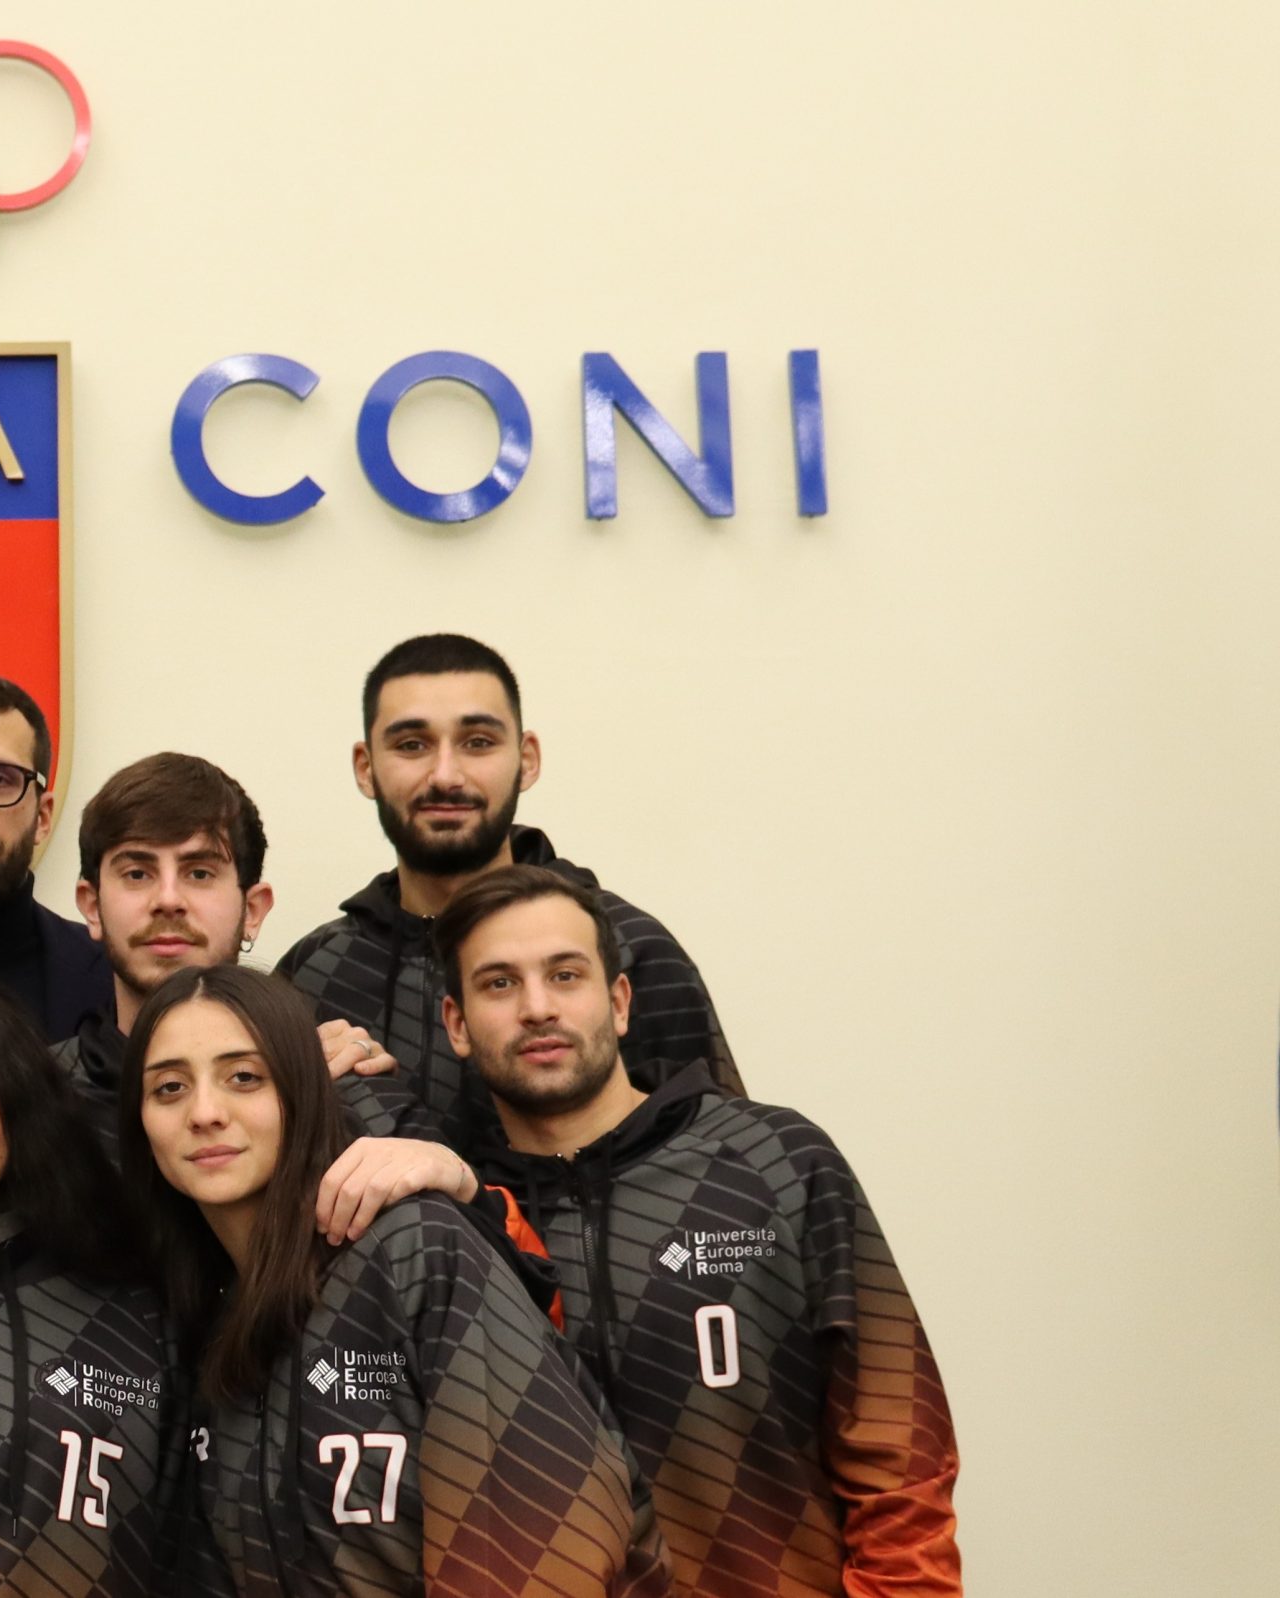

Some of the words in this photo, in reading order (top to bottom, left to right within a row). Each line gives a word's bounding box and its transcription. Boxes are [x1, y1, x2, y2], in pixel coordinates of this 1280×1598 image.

[171, 349, 828, 526] CONI
[694, 1227, 777, 1245] Università
[695, 1244, 763, 1261] Europea
[765, 1246, 776, 1258] di
[696, 1261, 744, 1276] Roma
[694, 1303, 741, 1389] 0
[82, 1363, 161, 1394] Università
[82, 1377, 145, 1406] Europea
[82, 1391, 124, 1417] Roma
[57, 1429, 124, 1530] 15
[318, 1432, 408, 1525] 27
